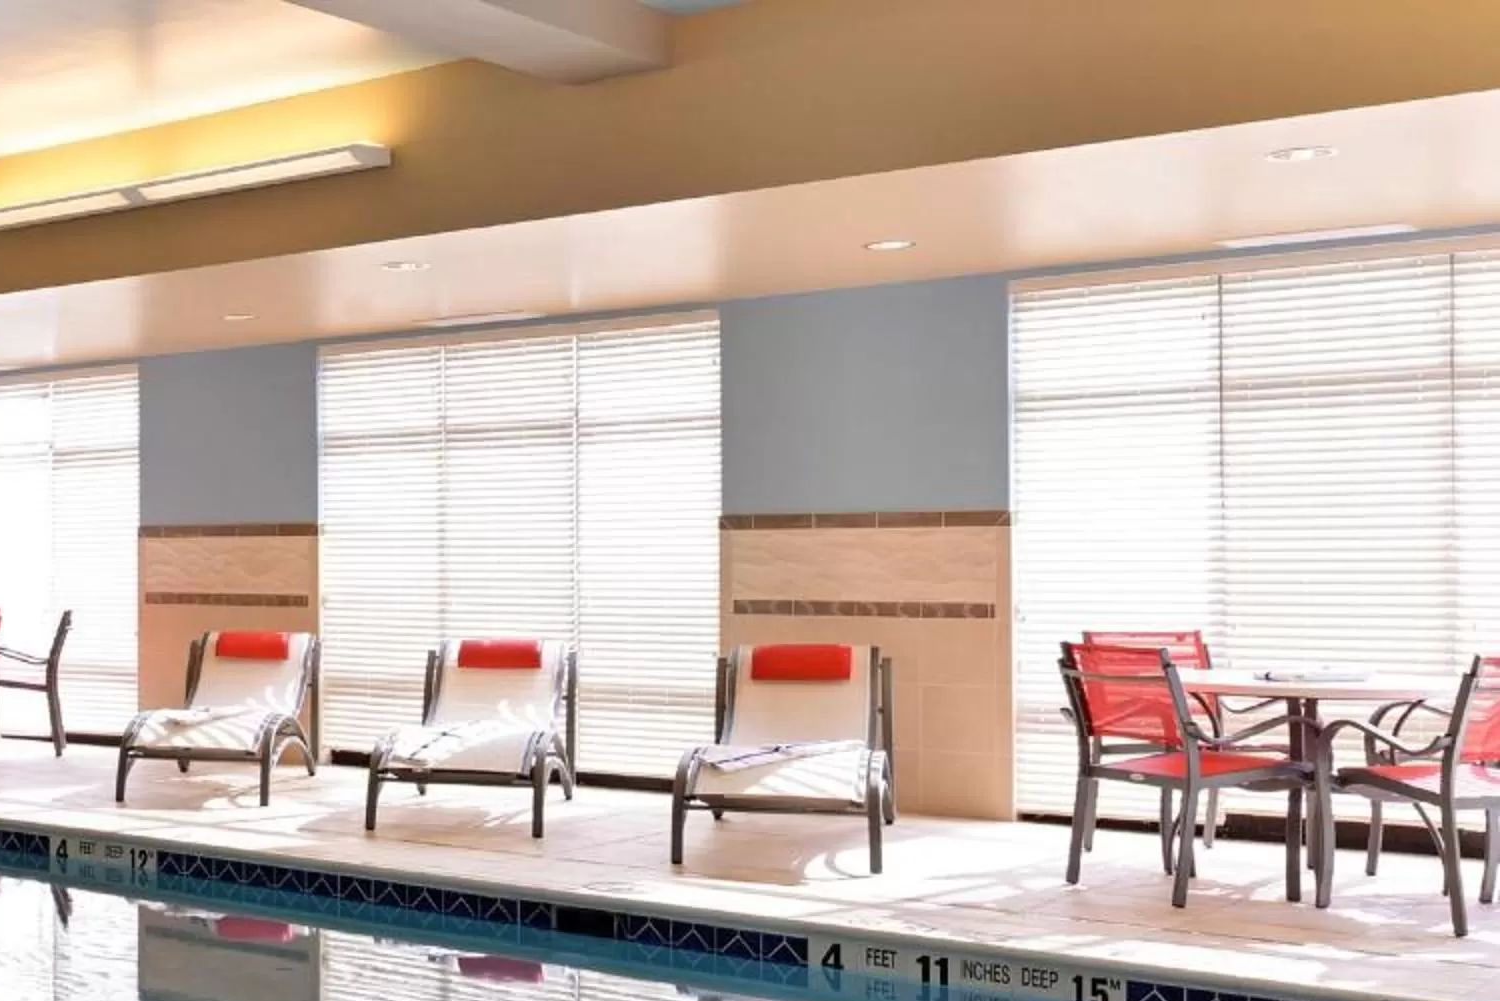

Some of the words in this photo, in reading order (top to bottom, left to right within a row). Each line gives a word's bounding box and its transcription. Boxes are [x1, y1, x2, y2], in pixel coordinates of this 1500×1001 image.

[821, 943, 844, 970] 4
[866, 947, 898, 969] FEET
[916, 955, 949, 986] 11
[1021, 967, 1059, 989] DEEP
